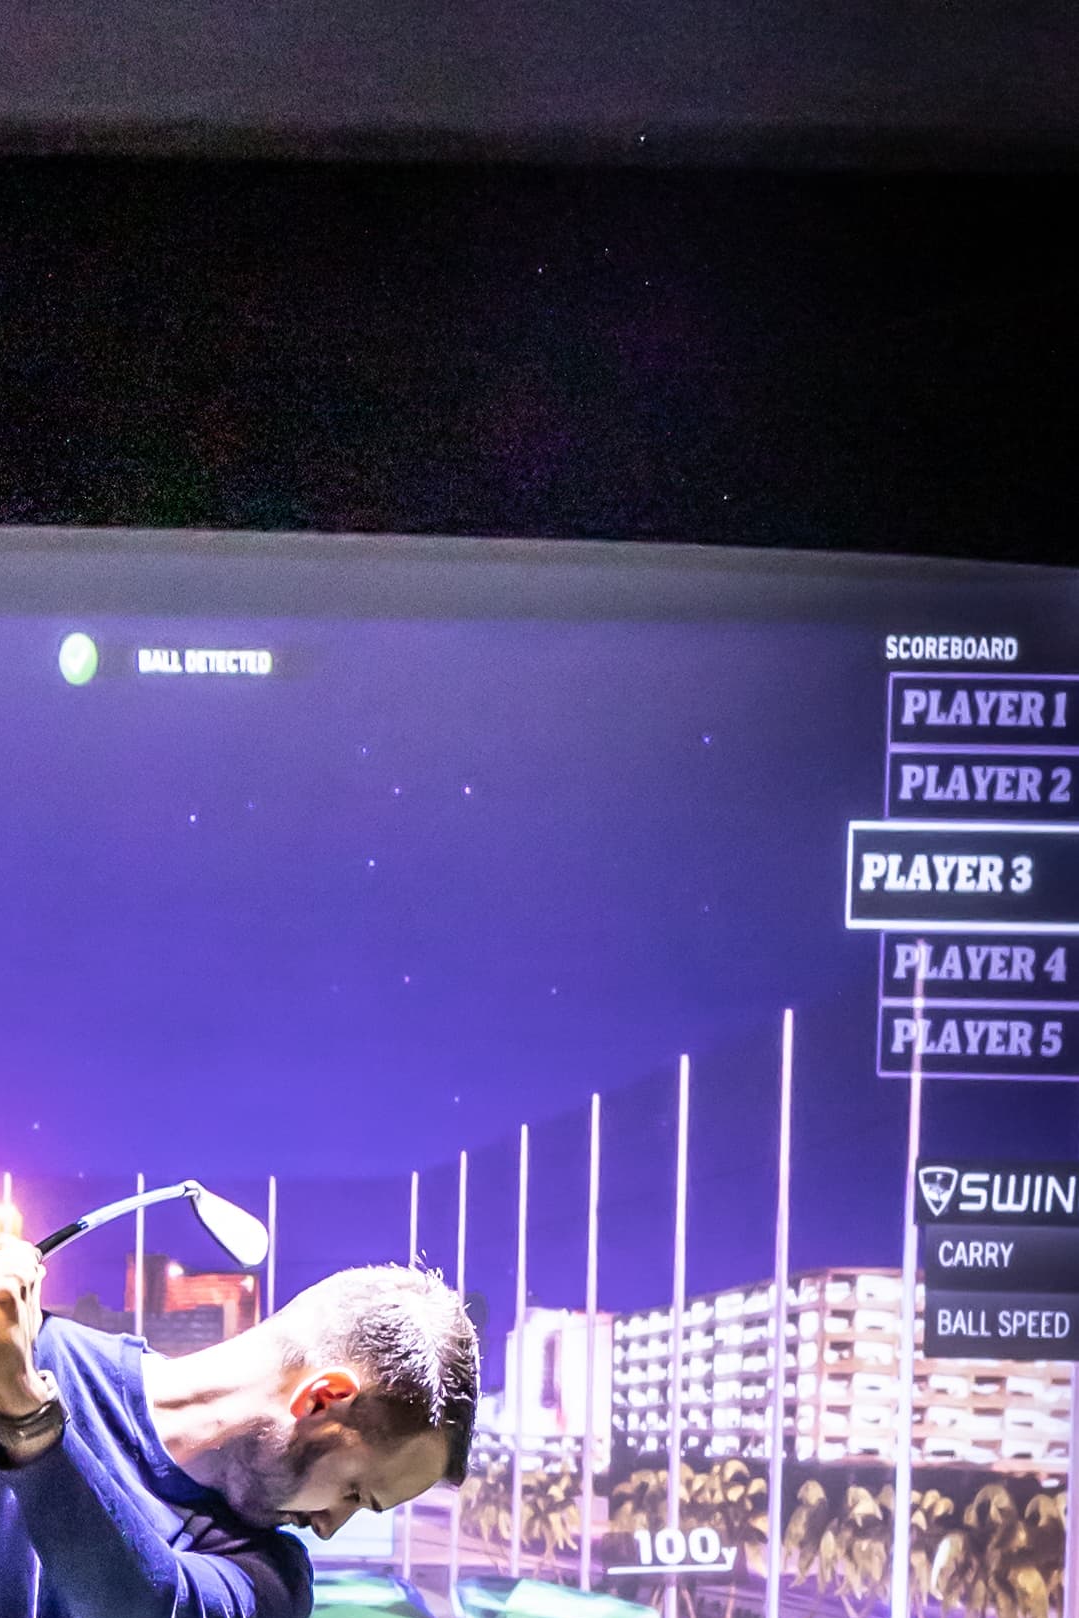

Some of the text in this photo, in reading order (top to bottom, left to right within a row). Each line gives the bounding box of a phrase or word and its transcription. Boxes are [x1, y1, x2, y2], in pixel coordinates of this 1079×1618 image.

[137, 649, 272, 674] BALL DETECTED
[885, 634, 1019, 661] SCOREBOARD
[901, 689, 1067, 728] PLAYER 1
[899, 765, 1072, 803] PLAYER 2
[859, 853, 1033, 893] PLAYER 3
[892, 944, 1067, 982] PLAYER 4
[890, 1018, 1063, 1057] PLAYER 5
[938, 1240, 1014, 1268] CARRY
[937, 1309, 1071, 1339] BALL SPEED
